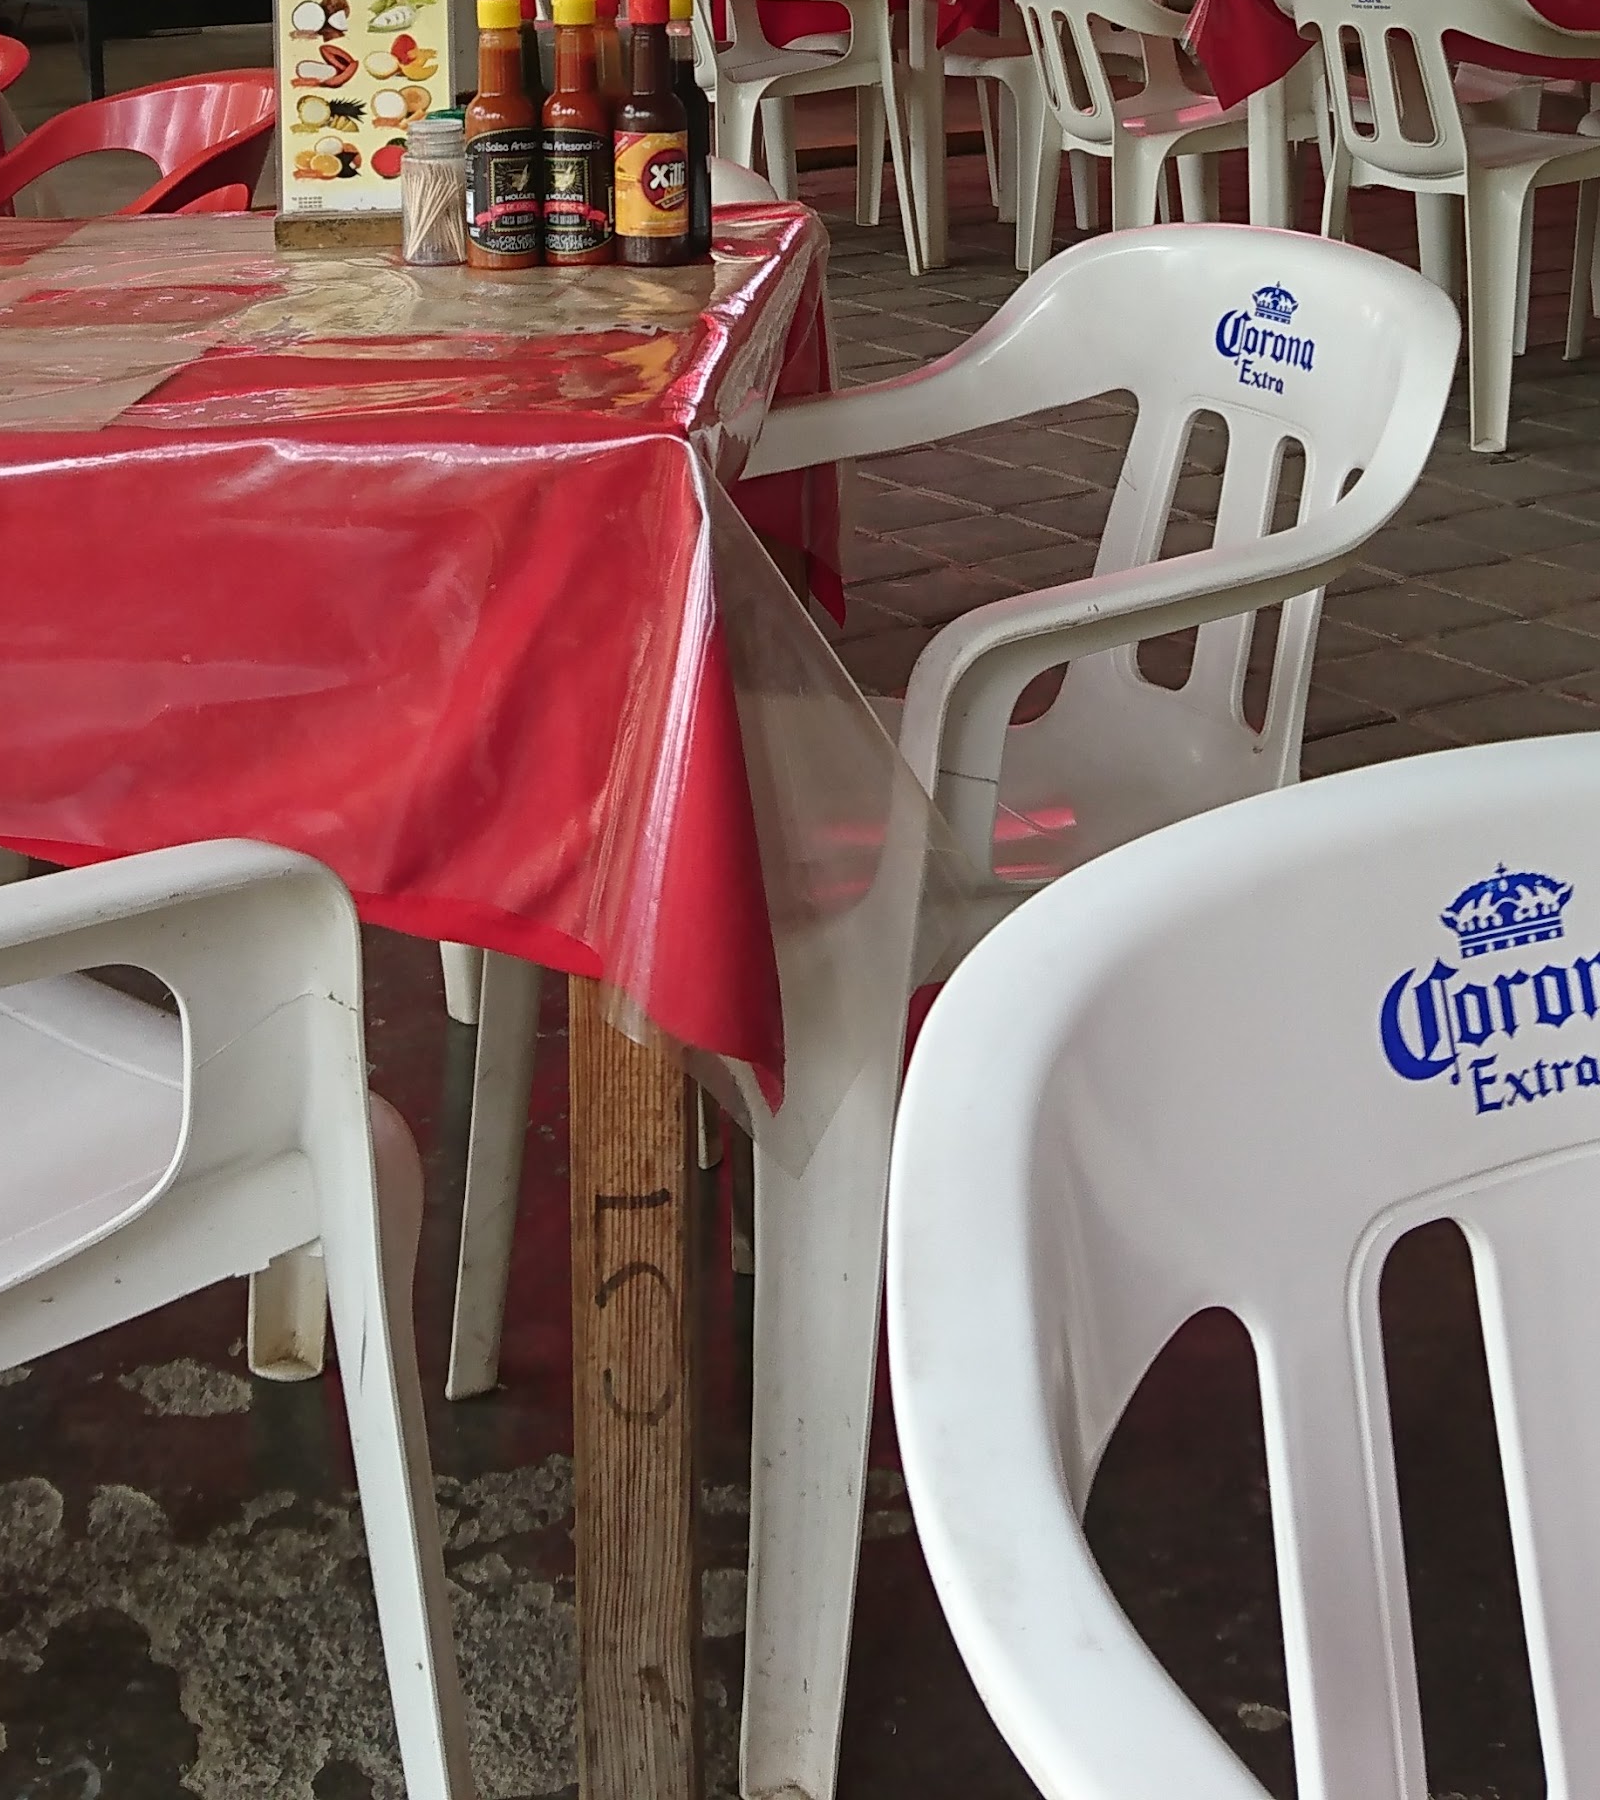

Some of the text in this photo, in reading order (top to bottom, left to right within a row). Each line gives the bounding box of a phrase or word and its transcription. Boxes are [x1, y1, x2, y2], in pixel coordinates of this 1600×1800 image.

[486, 141, 509, 153] Salsa
[1215, 309, 1315, 372] Corona
[1239, 358, 1284, 395] Extra
